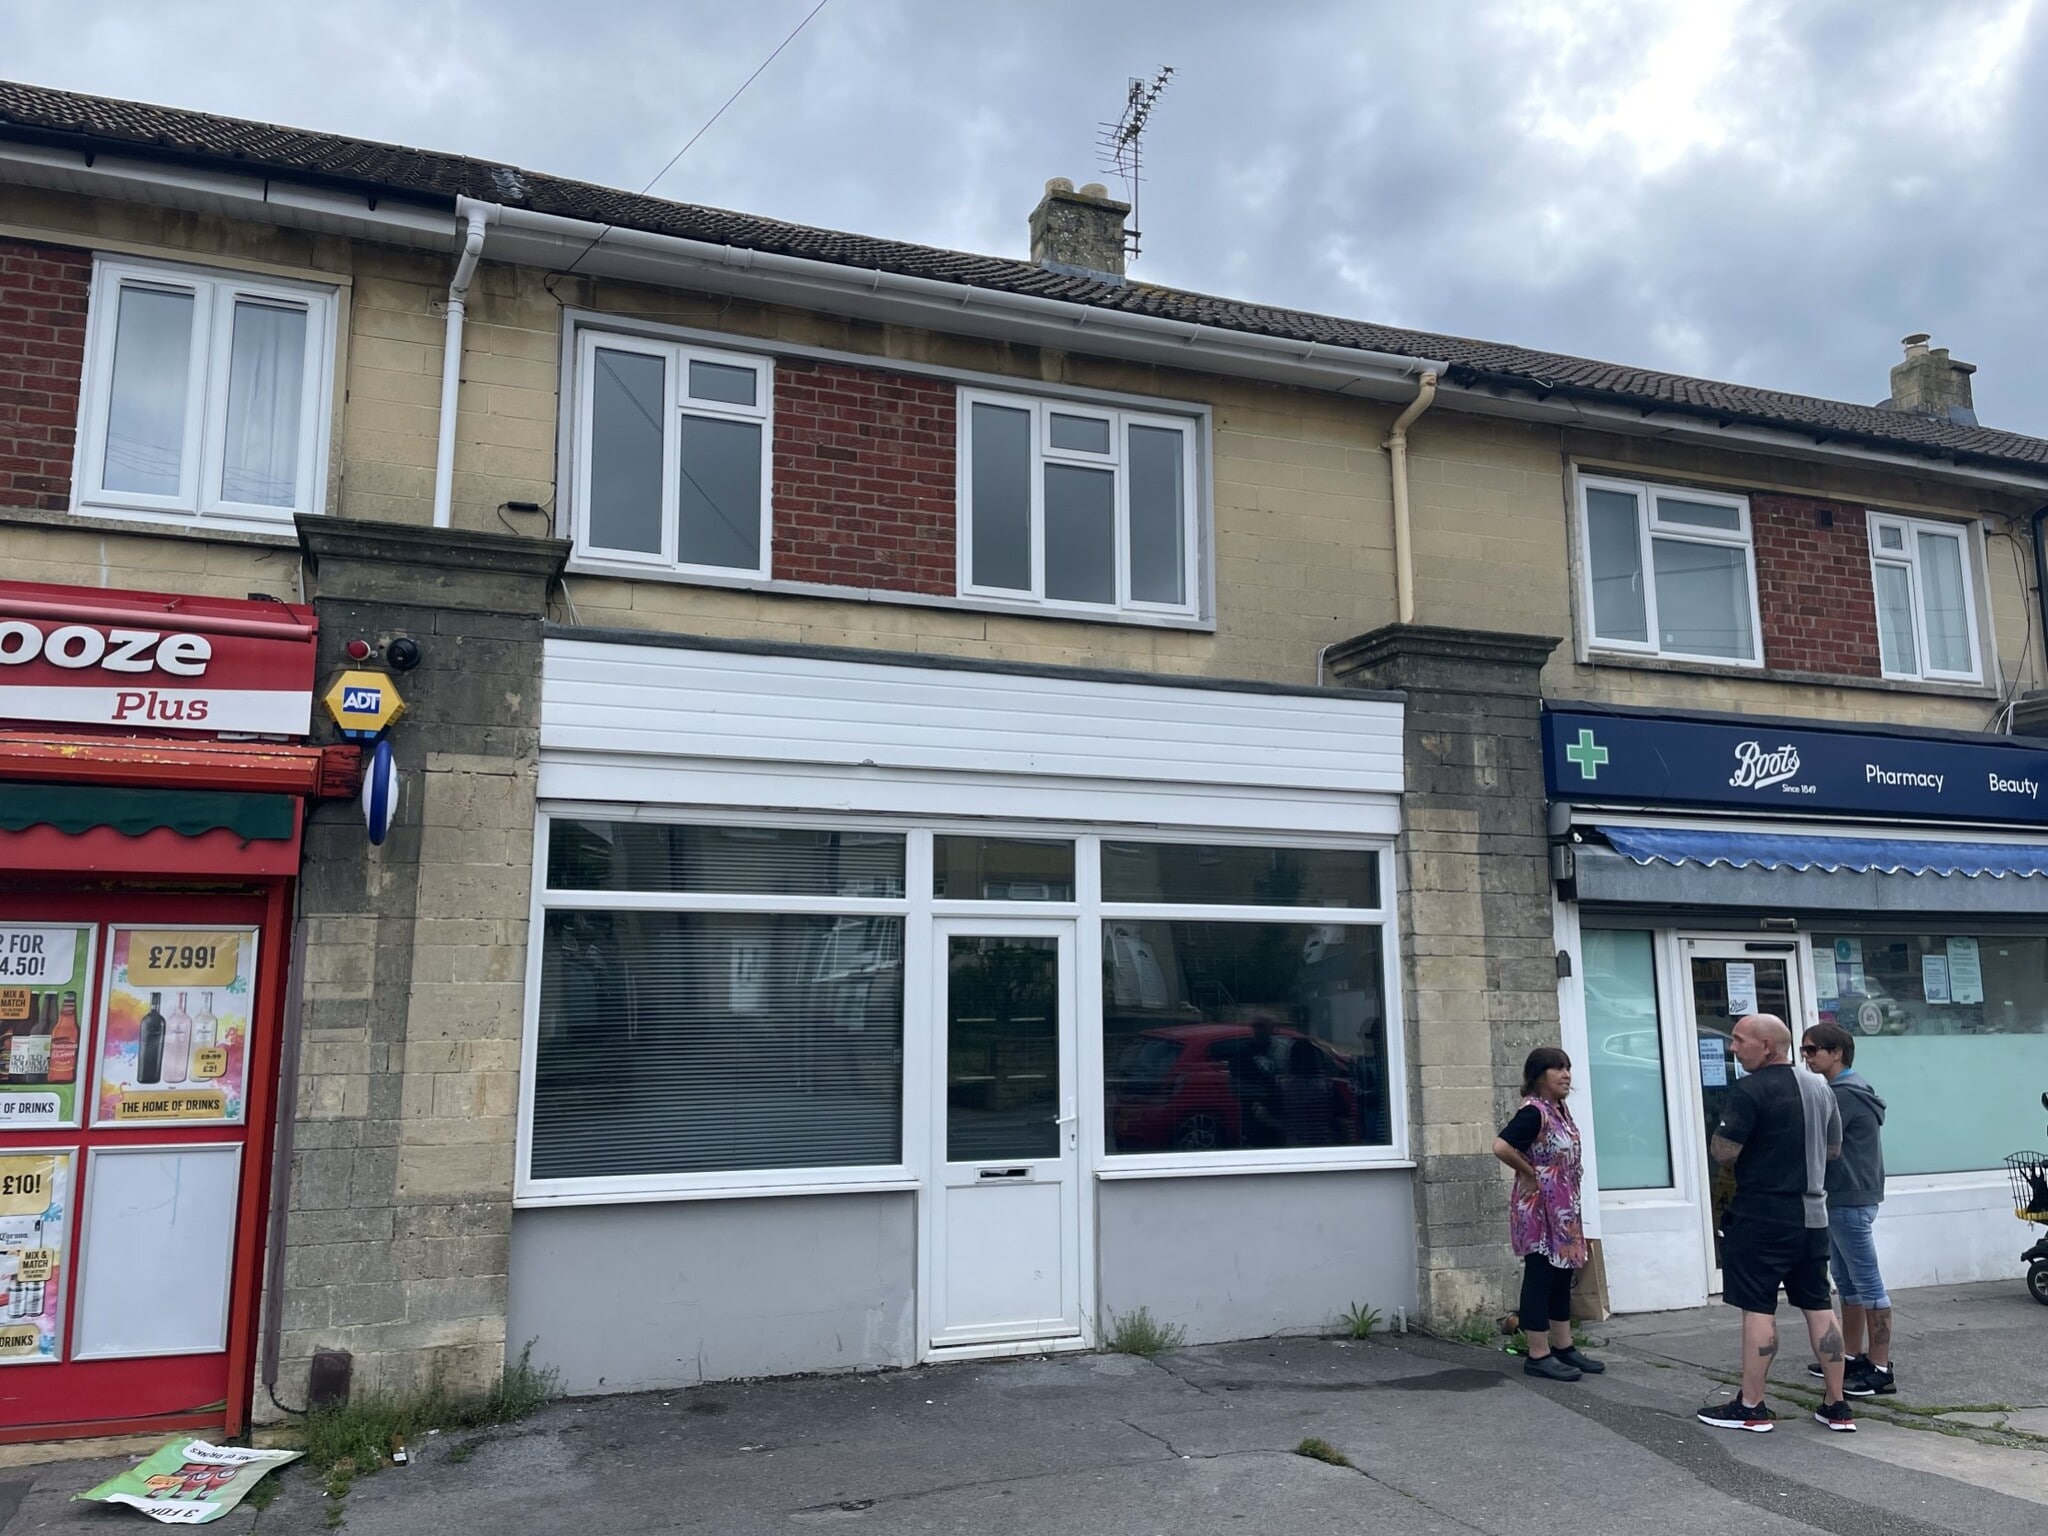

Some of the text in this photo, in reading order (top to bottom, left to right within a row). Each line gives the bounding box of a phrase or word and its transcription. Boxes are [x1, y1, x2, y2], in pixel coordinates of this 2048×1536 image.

[111, 690, 209, 721] Plus
[343, 691, 381, 711] ADT
[1728, 740, 1801, 790] Boots
[1782, 783, 1817, 794] Since 1849
[1865, 763, 2039, 800] Pharmacy Beauty
[9, 934, 44, 954] FOR
[148, 945, 217, 969] £7.99!
[4, 1102, 54, 1113] OF DRINKS
[122, 1099, 220, 1113] THE HOME OF DRINKS
[2, 1174, 41, 1195] £10!
[22, 1260, 48, 1269] MATCH
[25, 1251, 40, 1260] MIX
